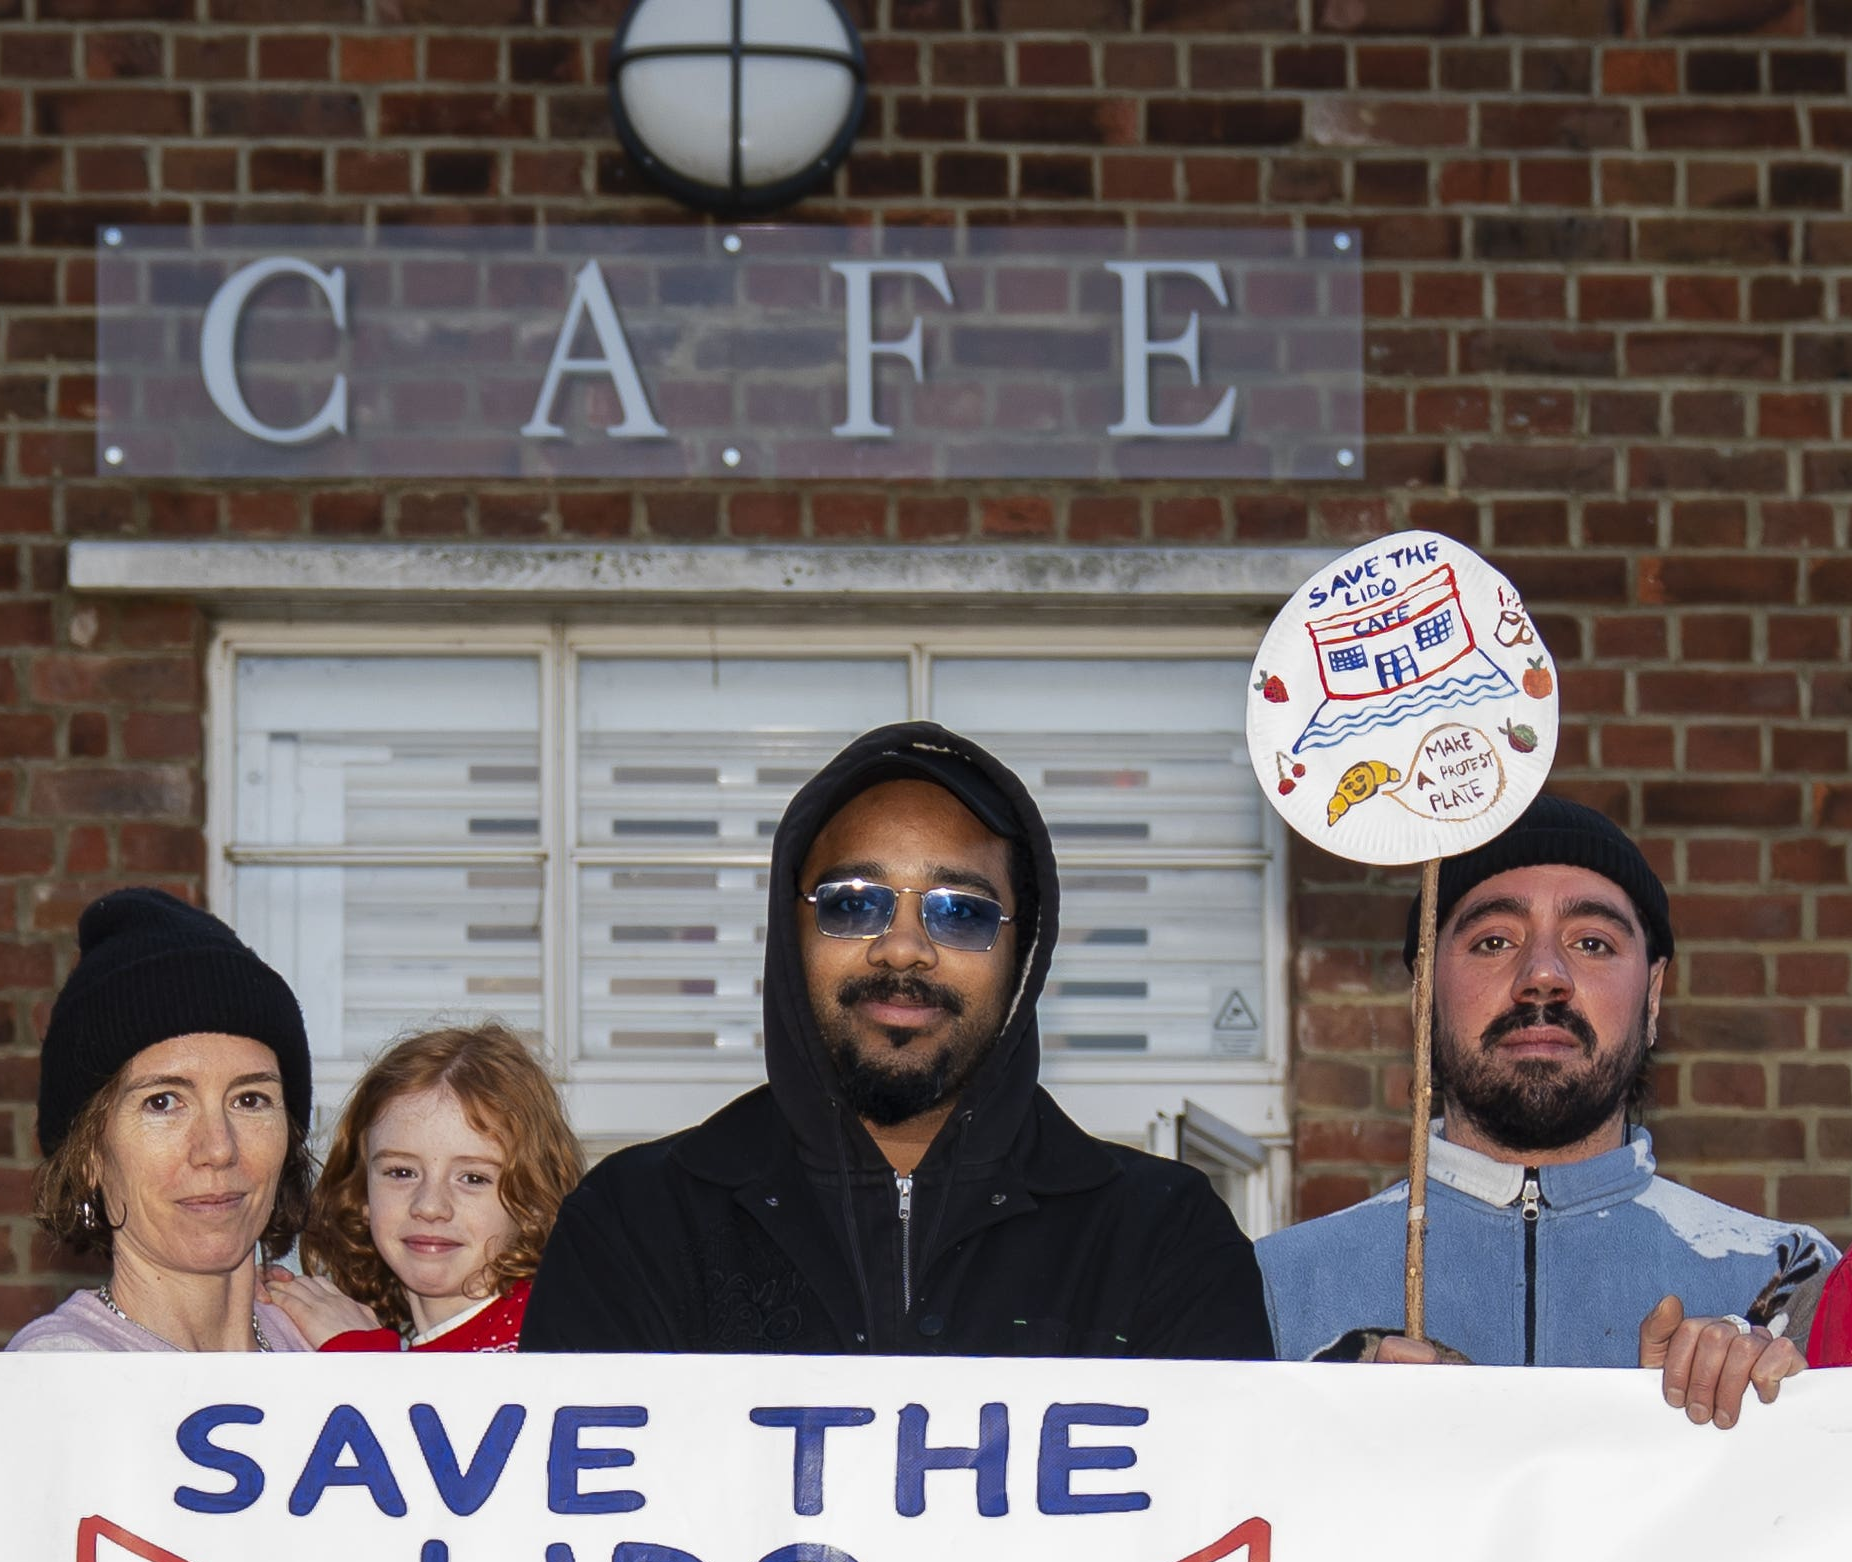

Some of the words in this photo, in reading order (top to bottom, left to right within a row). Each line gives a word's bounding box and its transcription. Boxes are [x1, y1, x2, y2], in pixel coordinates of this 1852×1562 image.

[199, 256, 1240, 446] CAFE
[1309, 555, 1380, 610] SAVE
[1385, 540, 1439, 569] THE
[1345, 577, 1397, 607] LIDO
[1425, 731, 1474, 762] MAKE
[1417, 770, 1436, 791] A
[1439, 749, 1494, 780] PROTEST
[1429, 777, 1485, 813] PLATE
[173, 1402, 650, 1517] SAVE
[748, 1401, 1152, 1518] THE
